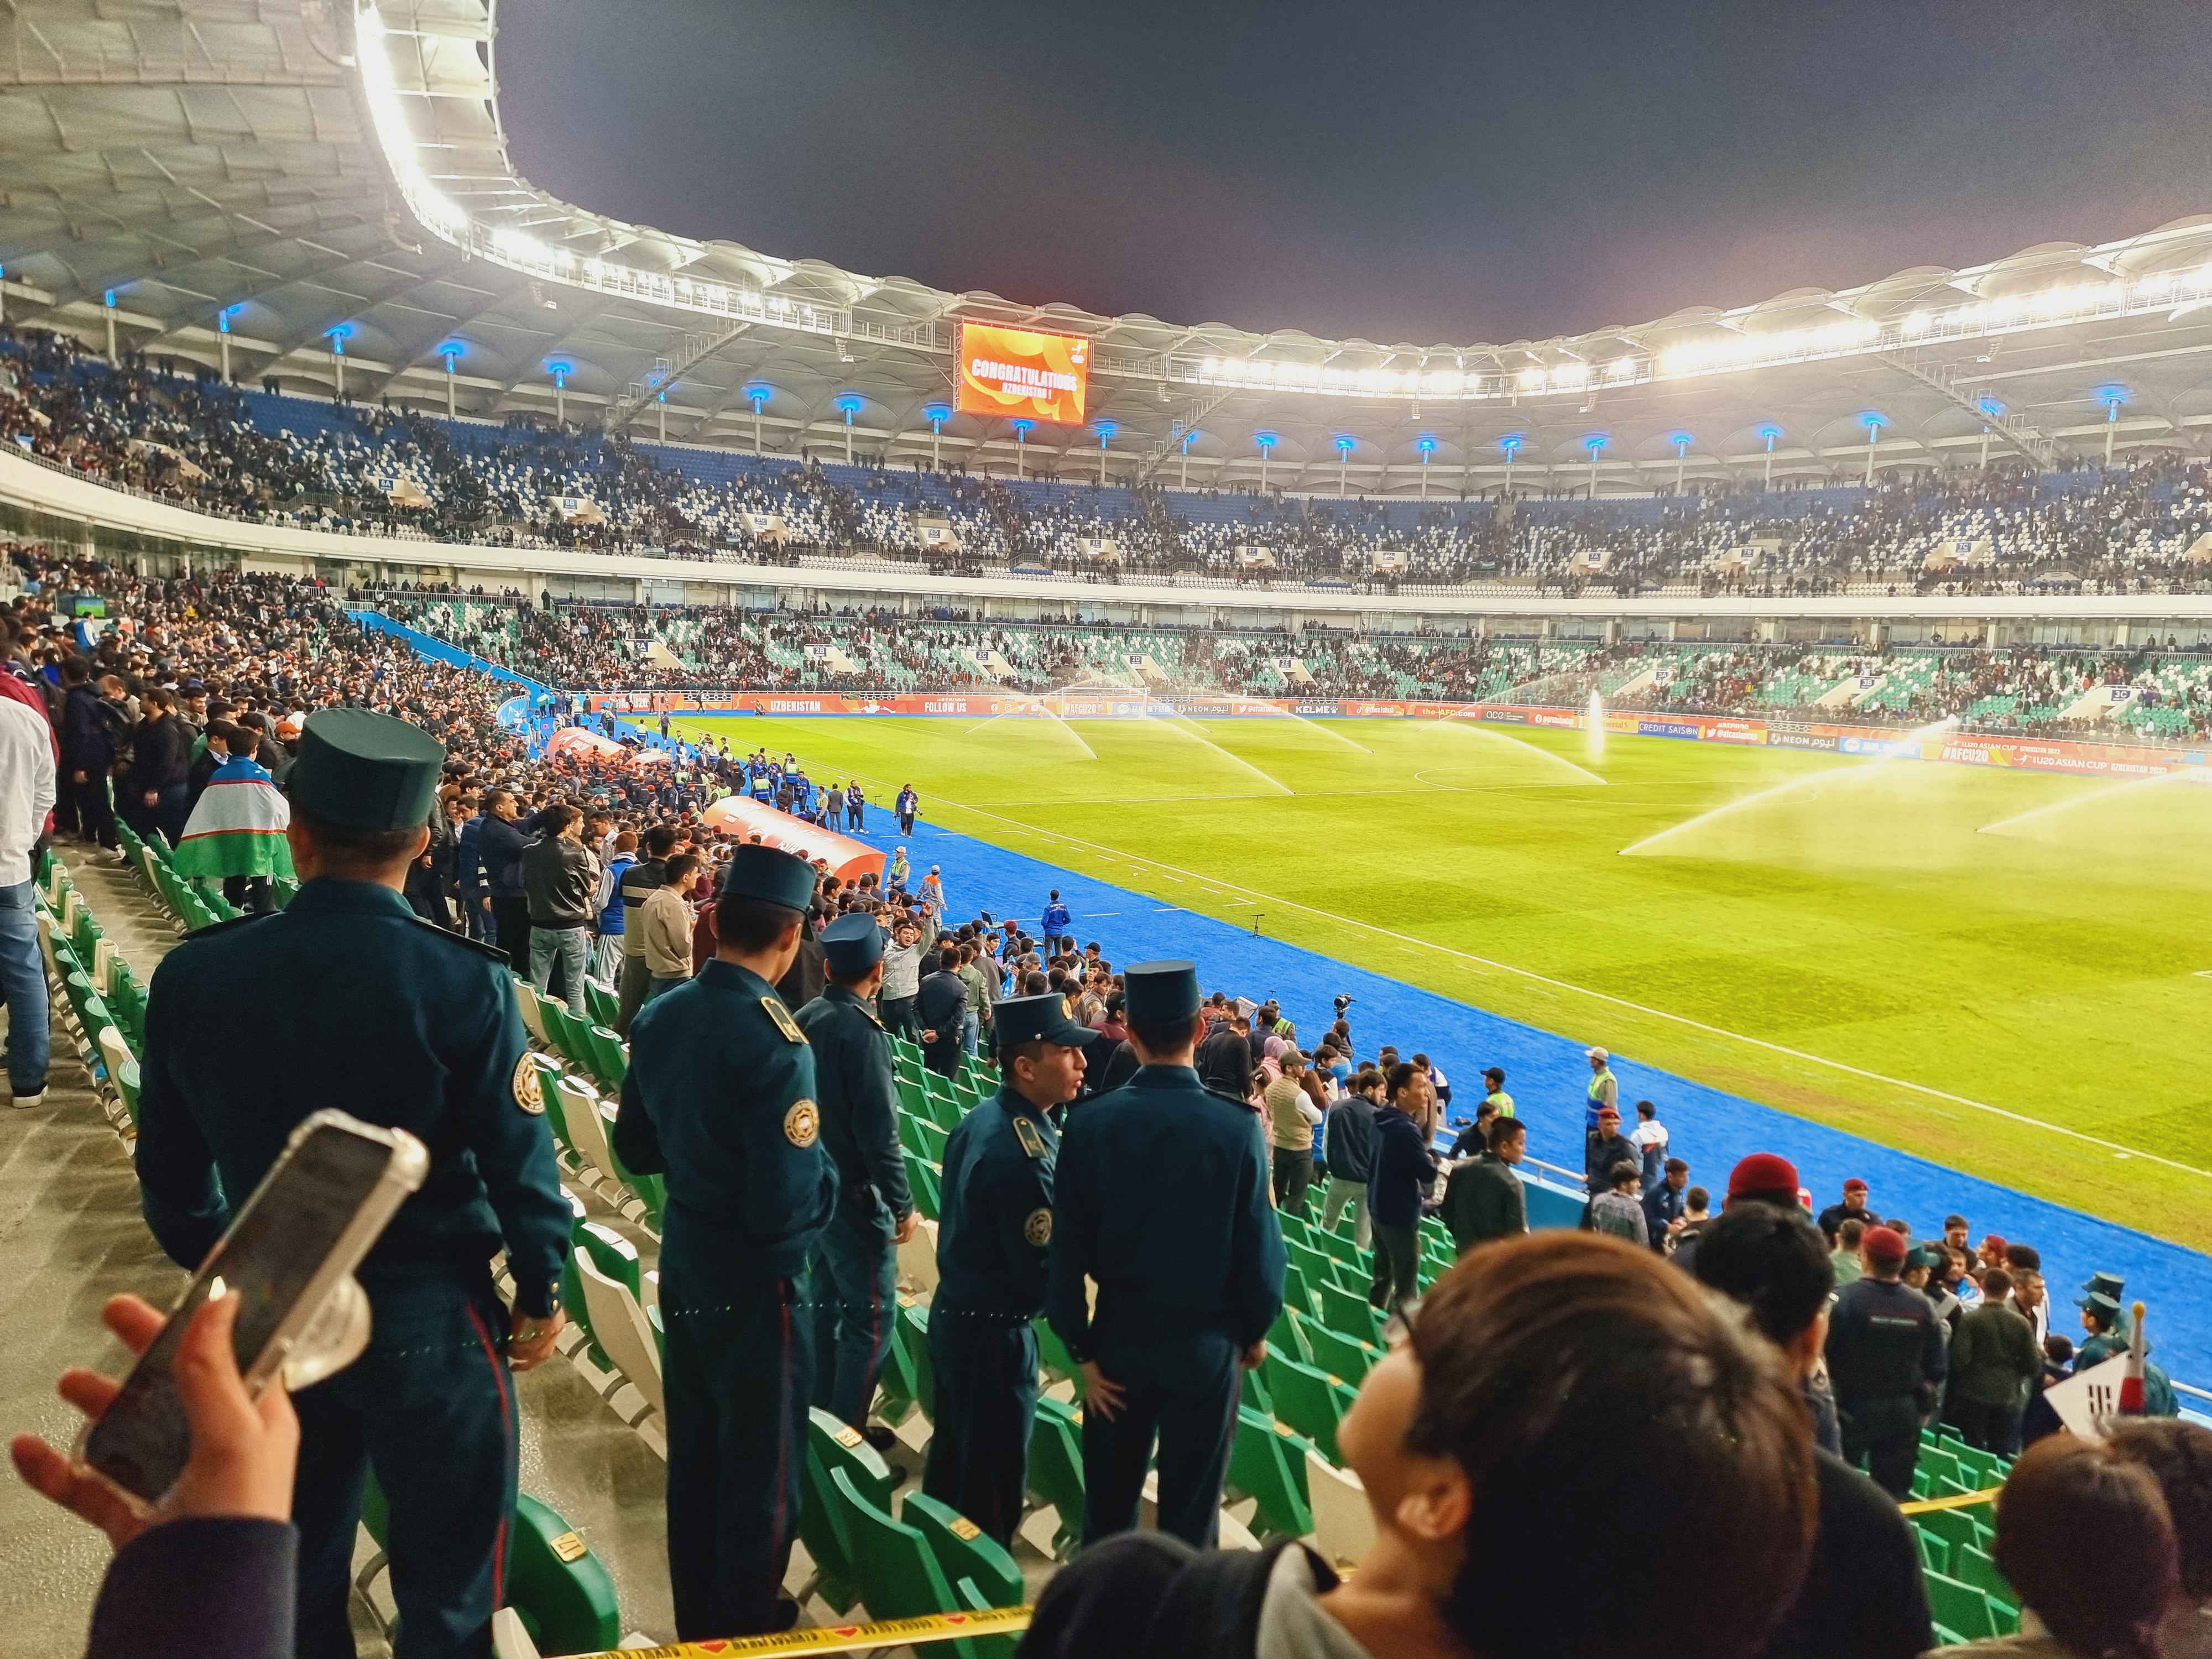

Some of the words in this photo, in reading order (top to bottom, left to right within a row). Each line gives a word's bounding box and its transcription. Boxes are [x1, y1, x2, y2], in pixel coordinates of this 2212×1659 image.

[972, 358, 1077, 392] CONGRATULATIONS
[1002, 382, 1046, 399] UZBEKISTAN
[770, 701, 821, 712] UZBEKISTAN
[925, 702, 955, 713] FOLLOW
[957, 702, 967, 712] US
[1065, 703, 1097, 714] #AFCU20
[1295, 706, 1330, 714] KELME
[1422, 708, 1476, 717] the-AFC.com
[1486, 711, 1504, 719] ace
[1639, 723, 1666, 732] CREDIT
[1668, 726, 1698, 735] SAISON
[1783, 735, 1809, 745] NEOM
[1942, 747, 1989, 763] #AFCU20
[2036, 756, 2054, 765] U20
[2055, 758, 2085, 768] ASIAN
[2086, 760, 2107, 770] CUP
[2111, 763, 2148, 774] UZBEKISTAN
[2149, 766, 2167, 775] 2023
[840, 1433, 856, 1444] 18
[557, 1540, 580, 1554] 17
